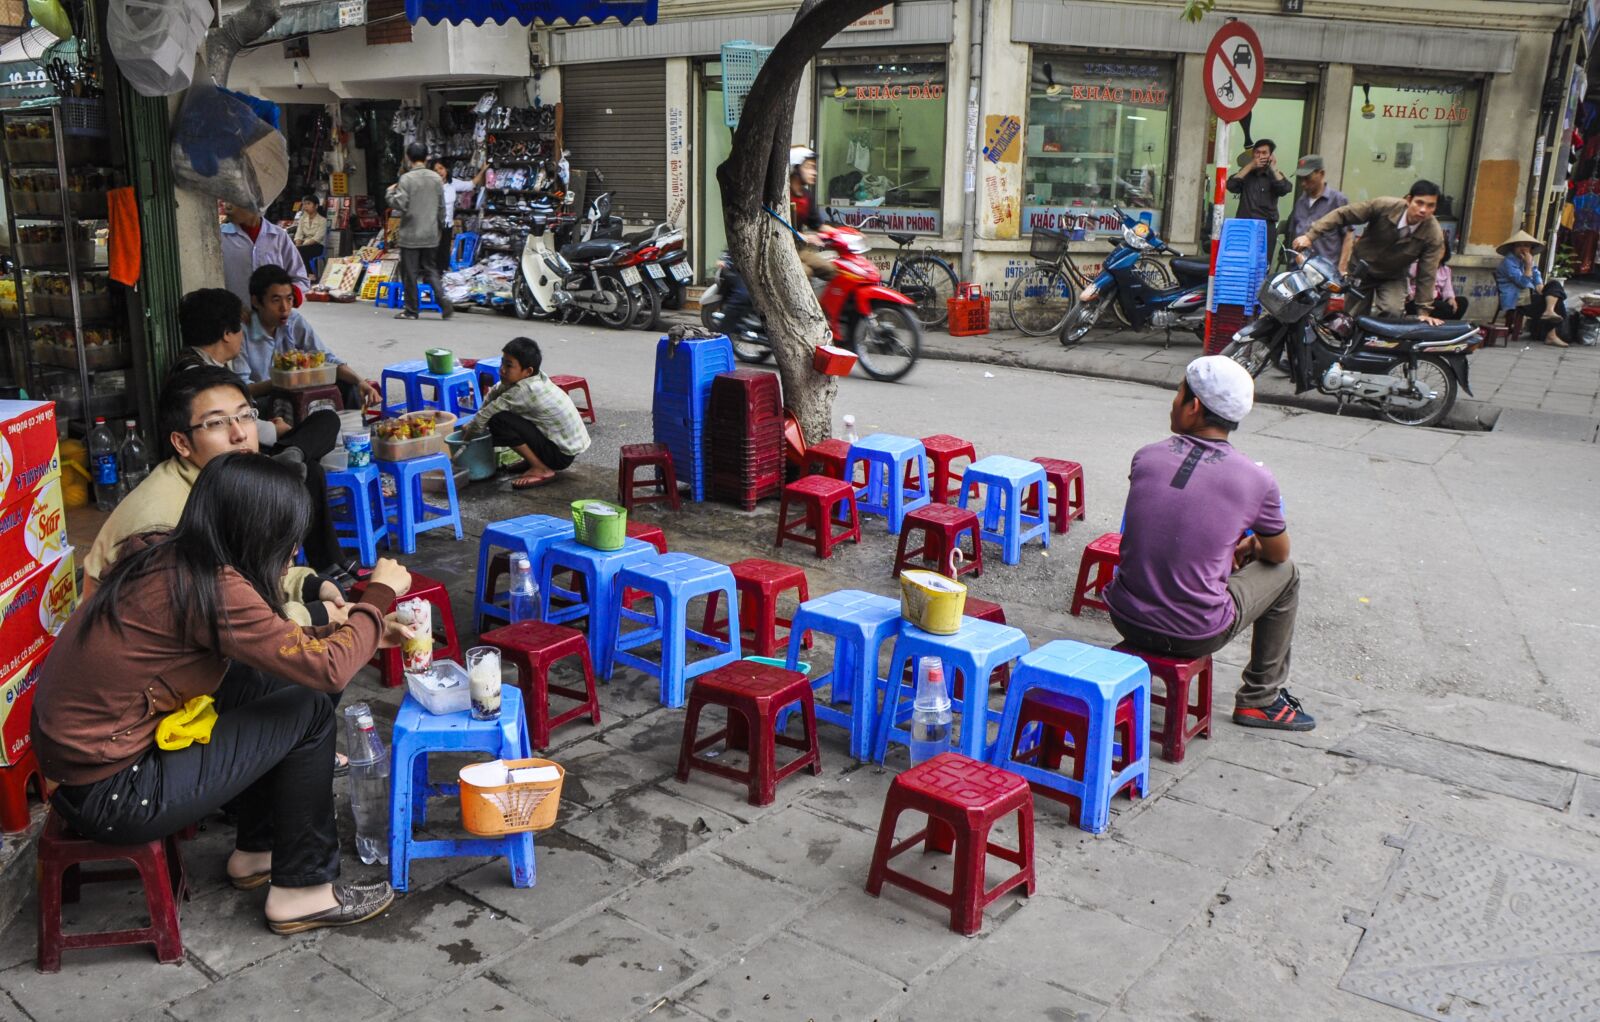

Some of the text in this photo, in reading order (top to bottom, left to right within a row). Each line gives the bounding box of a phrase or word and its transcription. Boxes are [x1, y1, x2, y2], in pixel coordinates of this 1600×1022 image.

[855, 77, 944, 101] KHẮC DẤU
[1071, 79, 1168, 105] KHẮC DẤU
[1382, 98, 1470, 121] KHẮC DẤU
[906, 212, 936, 231] PHÒNG
[1030, 208, 1055, 229] KHẮC
[15, 459, 52, 491] VINAMILK
[38, 507, 61, 541] Star
[1, 585, 38, 621] VINAMILK
[11, 735, 24, 754] SỮA
